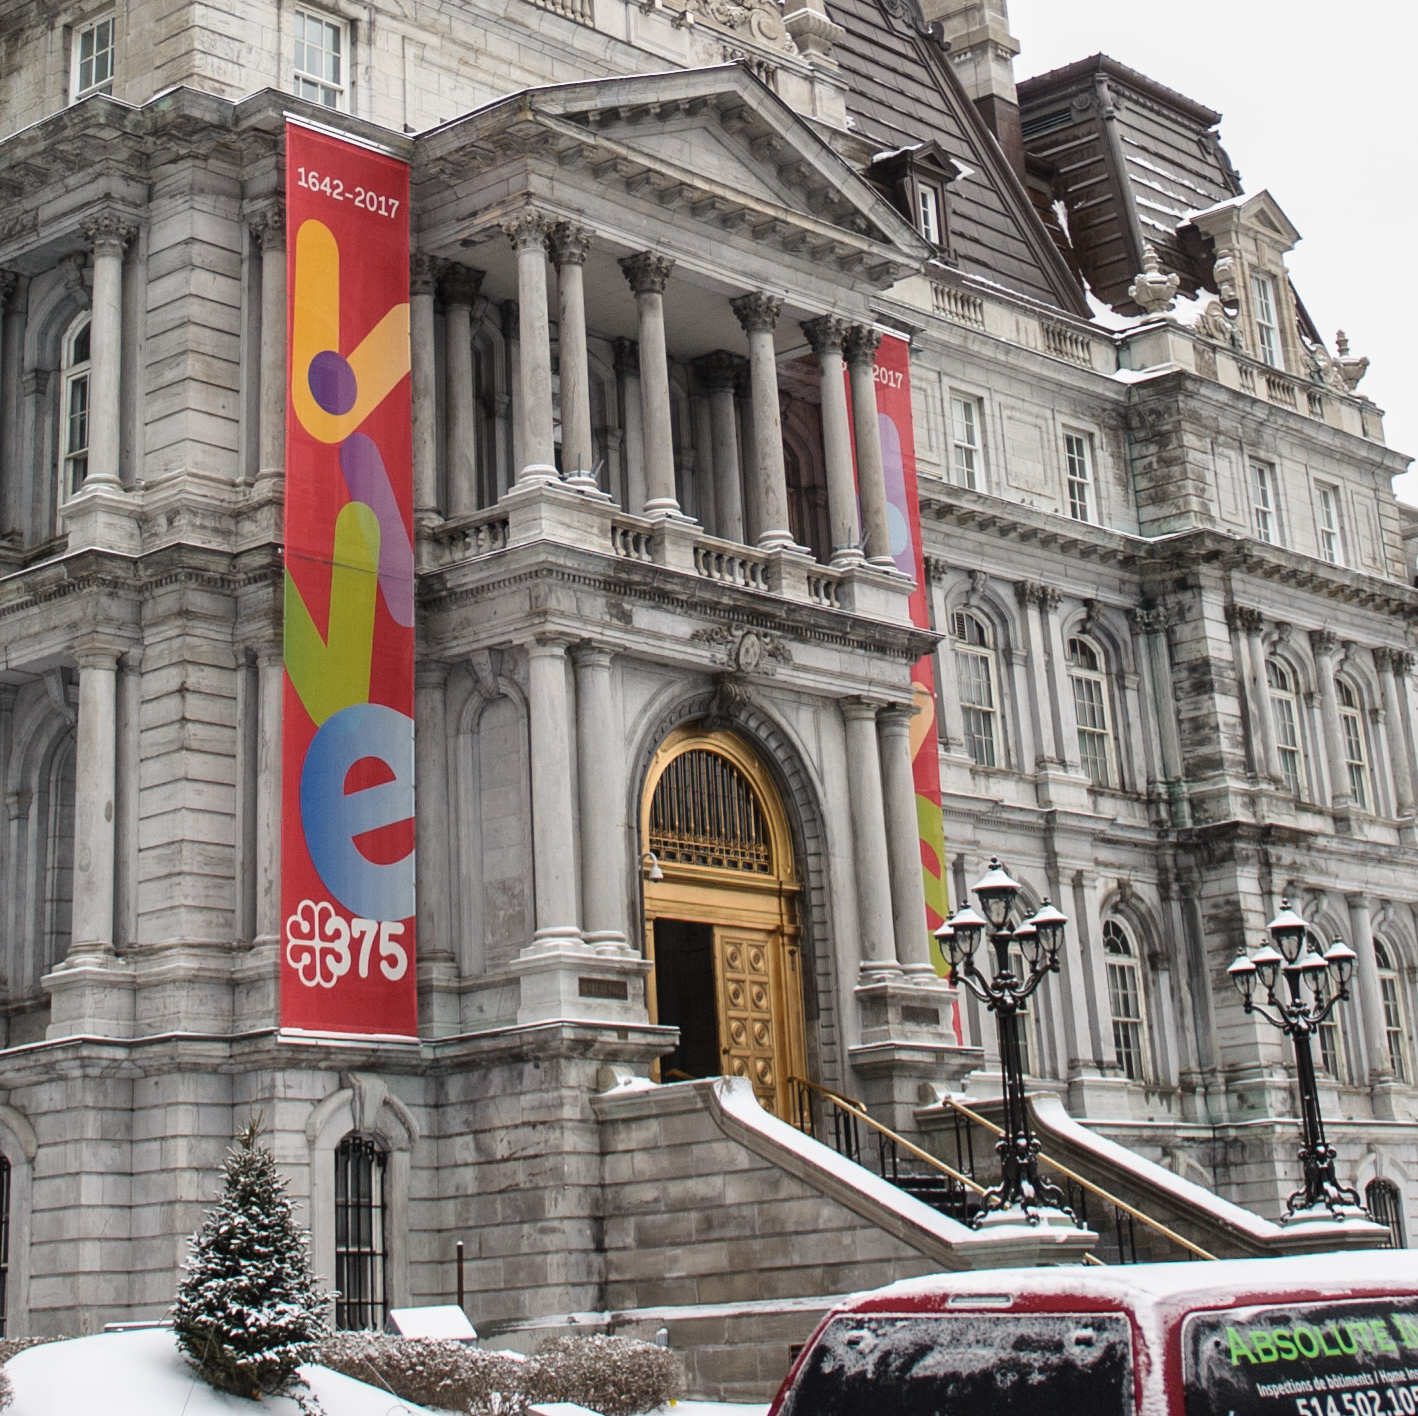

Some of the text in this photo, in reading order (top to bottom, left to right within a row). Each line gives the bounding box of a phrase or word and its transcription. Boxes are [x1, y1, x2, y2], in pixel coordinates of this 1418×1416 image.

[297, 166, 400, 219] 1642-2017
[325, 915, 409, 982] 375
[1226, 1320, 1398, 1366] ABSOLUTE
[1255, 1379, 1314, 1399] Inspections
[1313, 1375, 1328, 1391] de
[1378, 1368, 1408, 1384] Home
